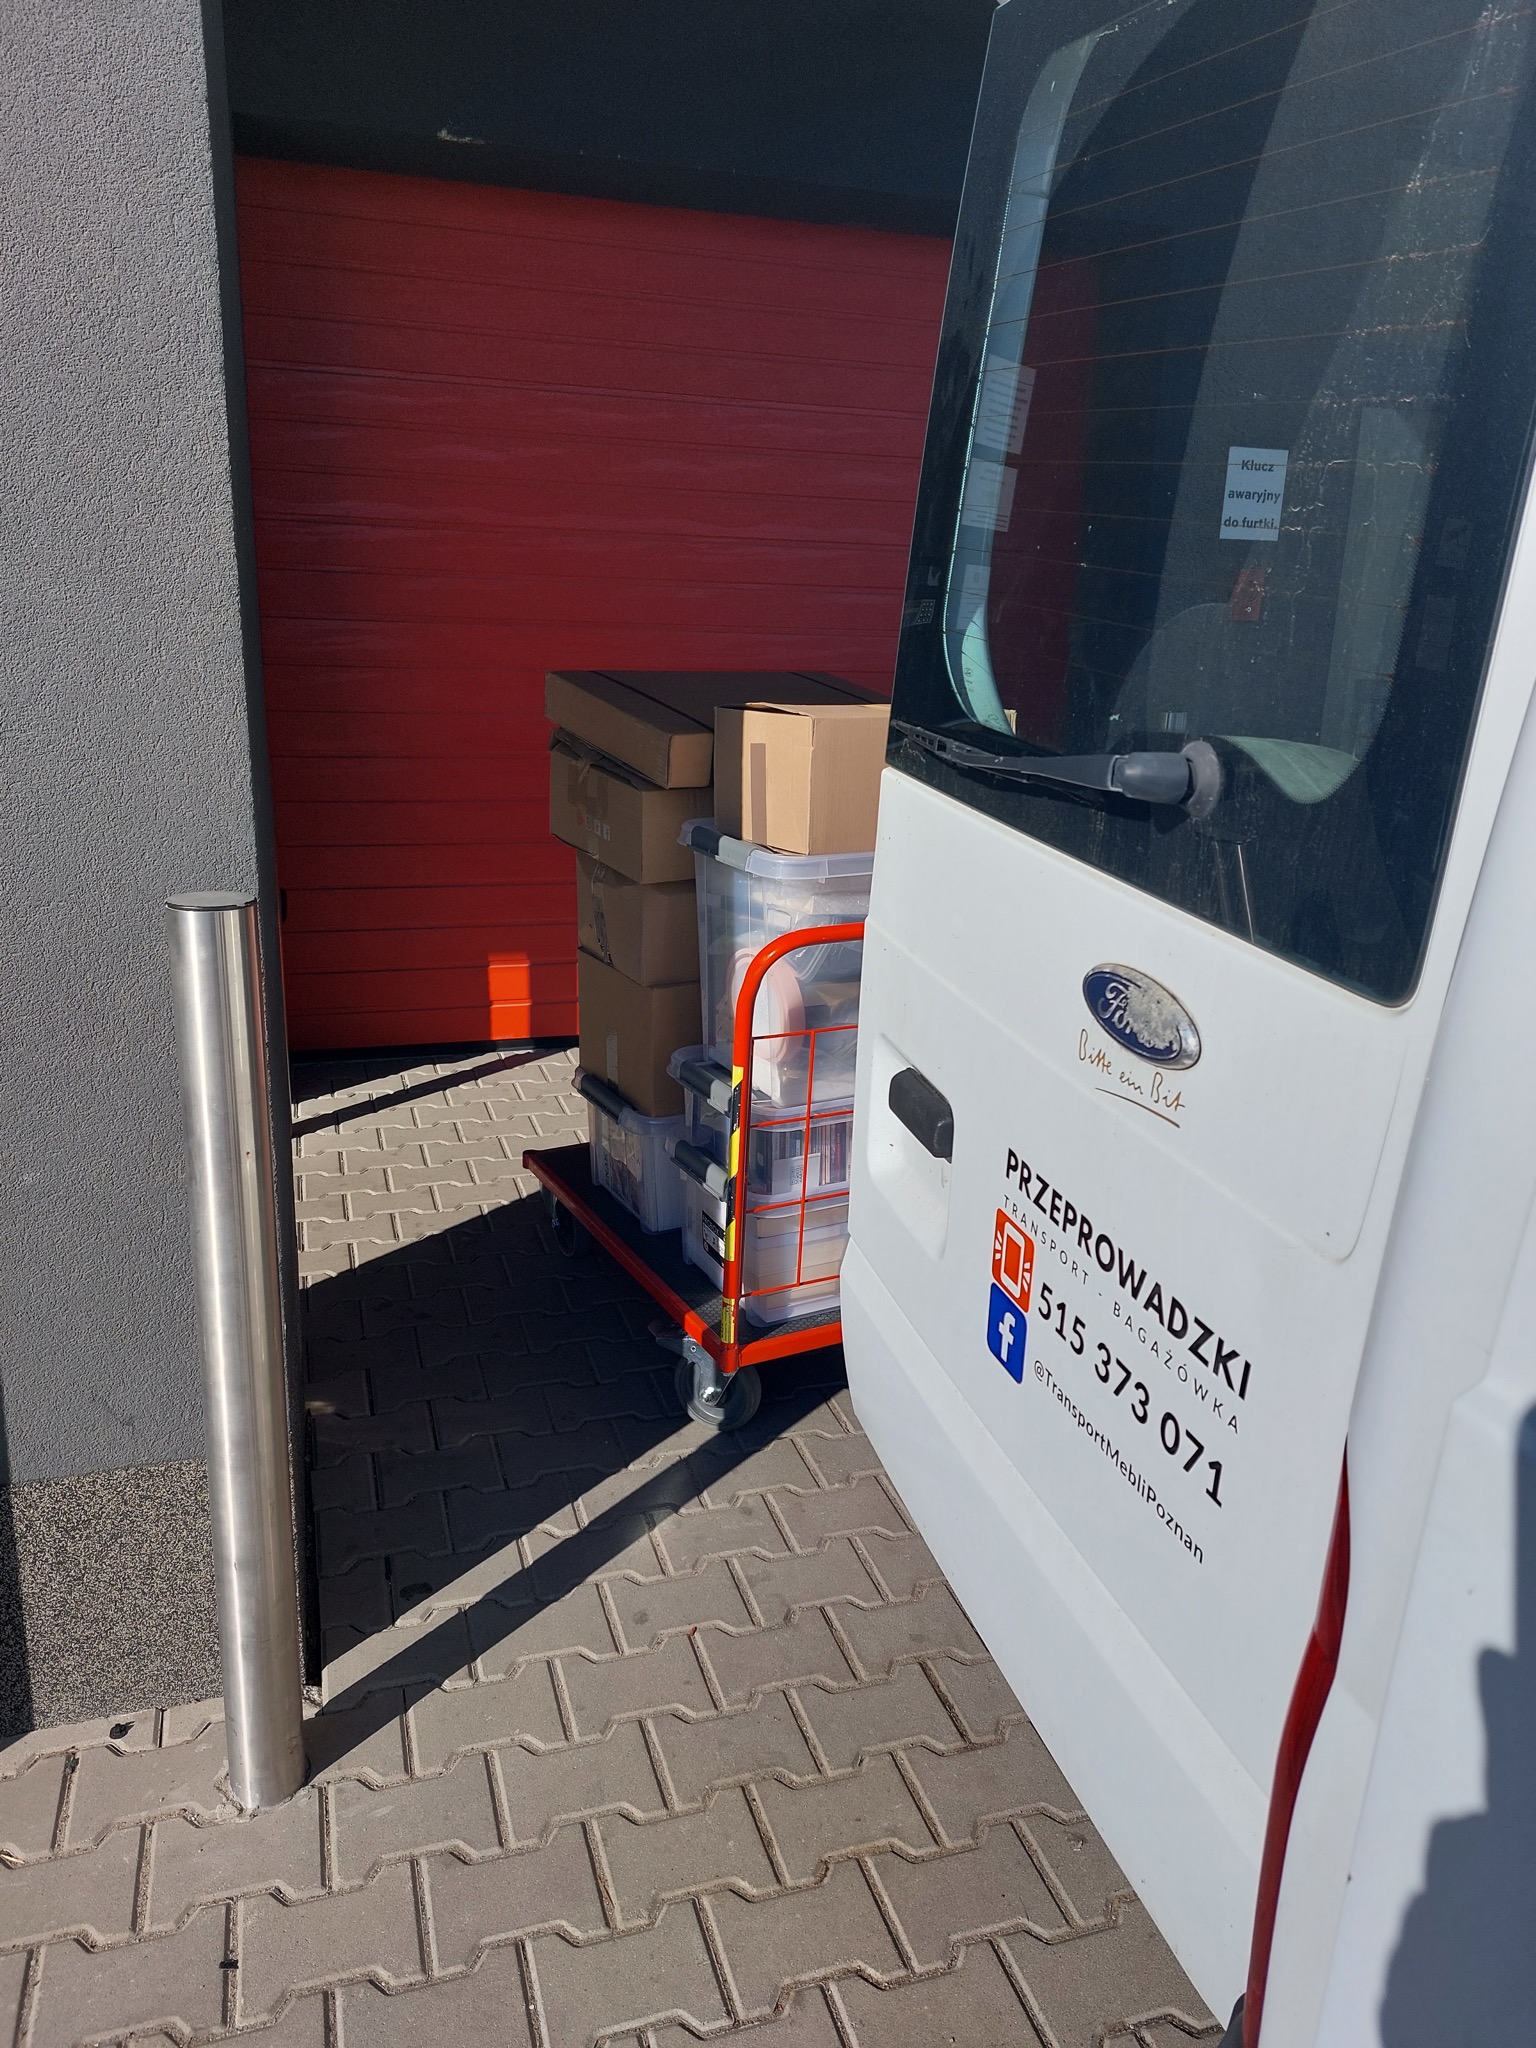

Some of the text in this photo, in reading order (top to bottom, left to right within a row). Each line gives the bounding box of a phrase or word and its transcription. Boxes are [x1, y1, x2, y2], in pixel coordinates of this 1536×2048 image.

[1223, 516, 1278, 529] do furtki.
[1228, 489, 1281, 504] awaryjny
[1241, 459, 1274, 472] Klucz
[1079, 1029, 1186, 1111] Bitte ein Bit
[1004, 1194, 1088, 1285] TRANSPORT
[1113, 1300, 1238, 1434] BAGAŻÓWKA
[1006, 1147, 1251, 1401] PRZEPROWADZKI
[1034, 1359, 1204, 1564] @TransportMebliPoznan
[1038, 1282, 1223, 1508] 515 373 071
